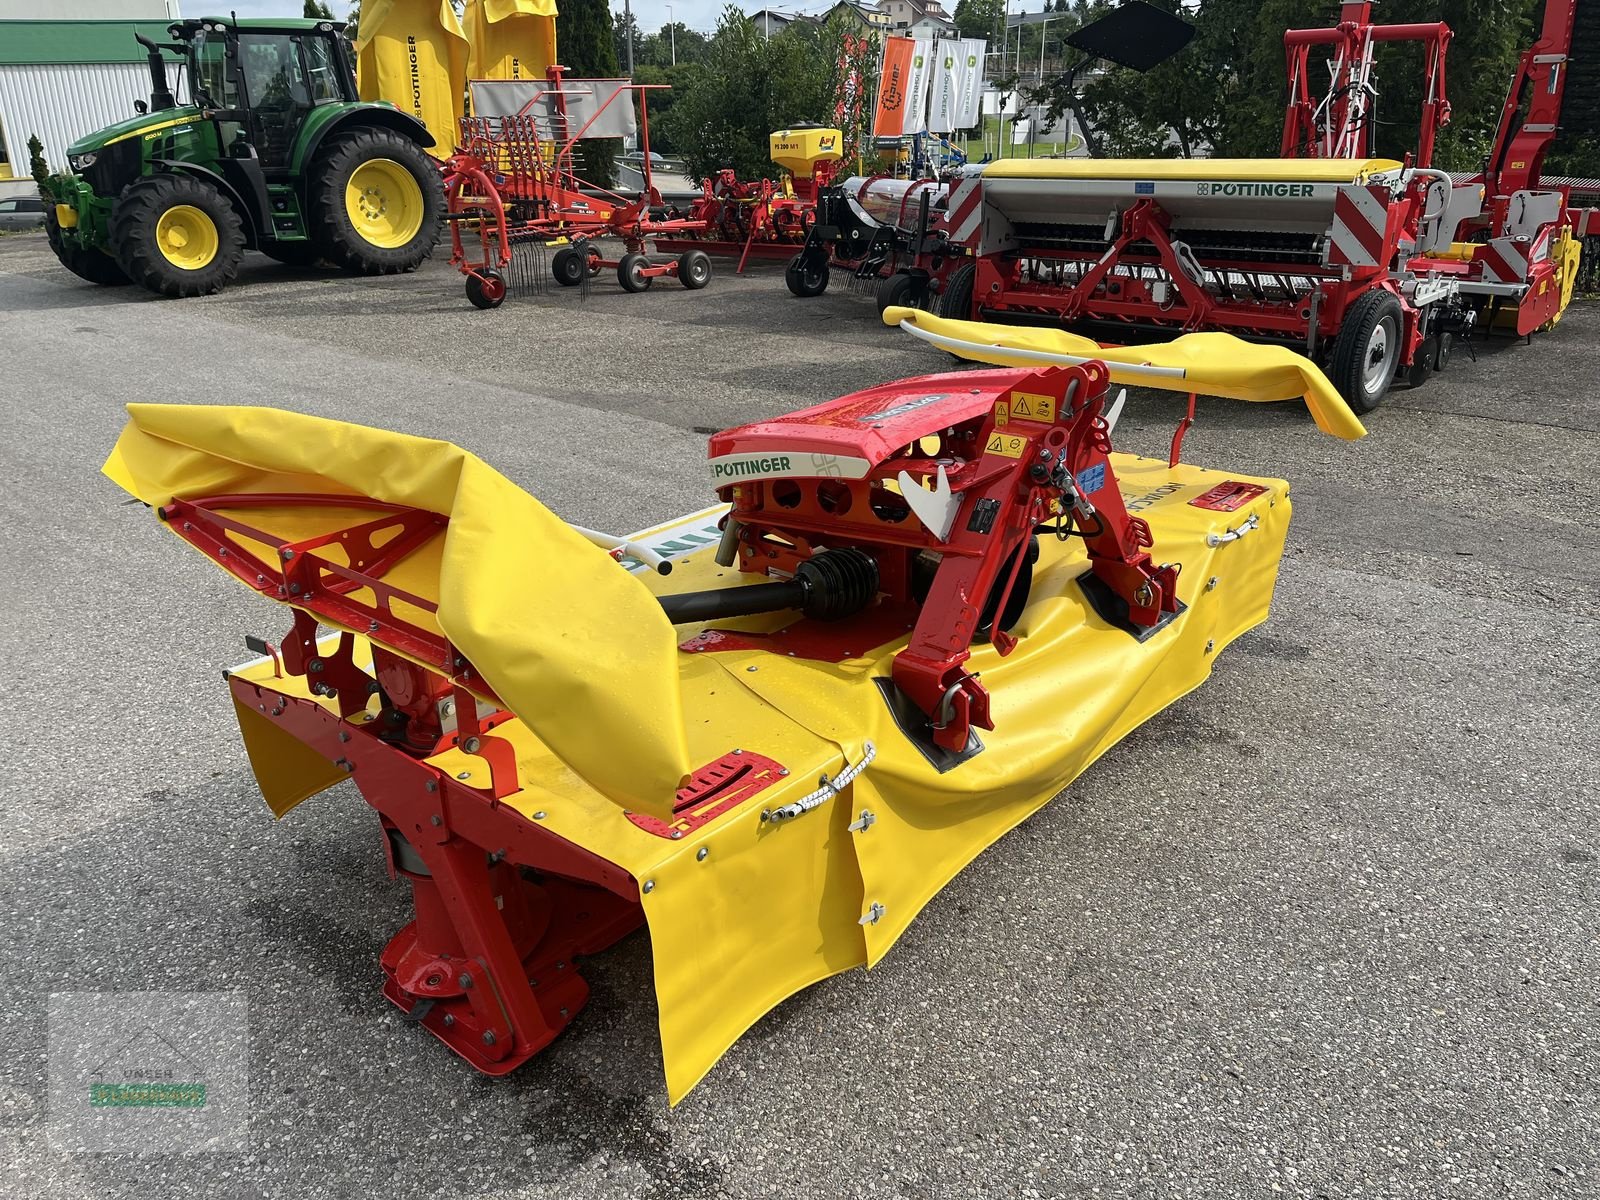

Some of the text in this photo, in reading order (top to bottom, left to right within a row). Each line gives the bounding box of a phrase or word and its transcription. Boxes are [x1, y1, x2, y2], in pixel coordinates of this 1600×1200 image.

[885, 63, 900, 104] hauer
[913, 73, 921, 94] JOHN
[940, 72, 951, 119] JOHN DEERE
[1127, 482, 1186, 512] NOVACA
